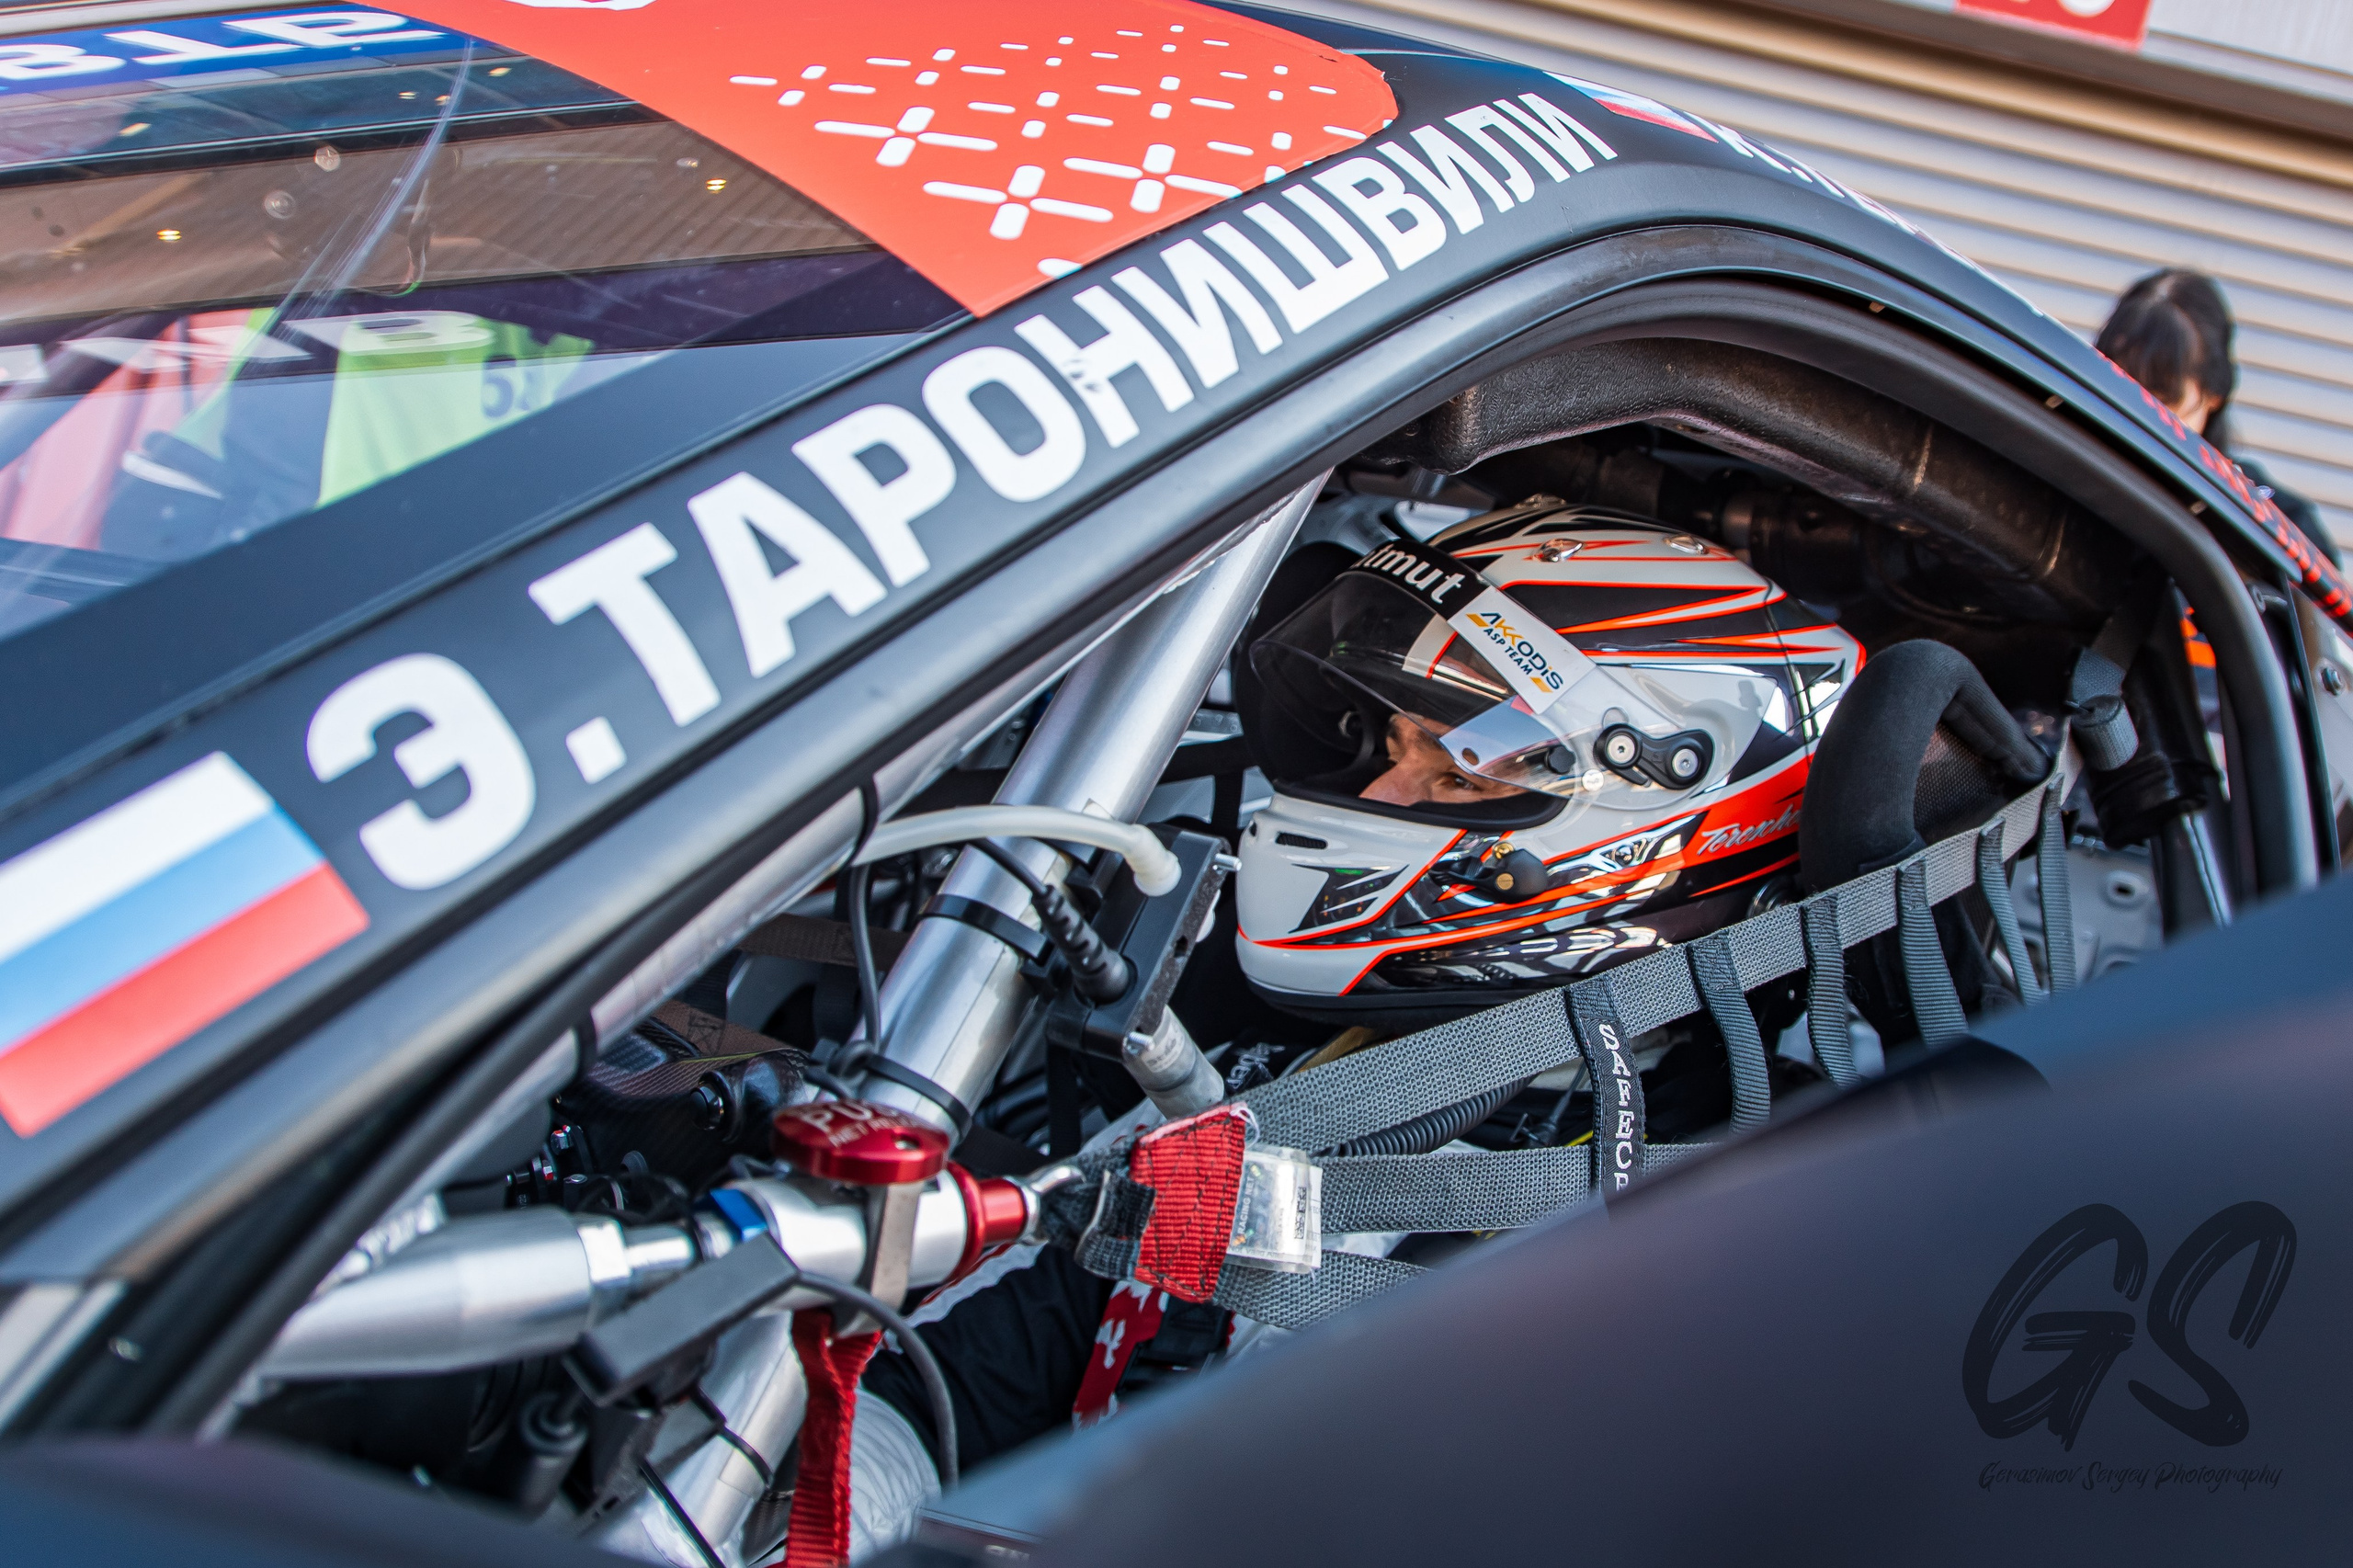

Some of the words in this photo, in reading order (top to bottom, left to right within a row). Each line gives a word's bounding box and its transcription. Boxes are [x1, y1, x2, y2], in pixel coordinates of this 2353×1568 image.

[305, 92, 1619, 891] Э.ТАРОНИШВИЛИ
[1483, 628, 1506, 648] ASP
[1505, 645, 1534, 676] TEAM
[1237, 1197, 1251, 1234] RACING
[1245, 1176, 1255, 1196] NET
